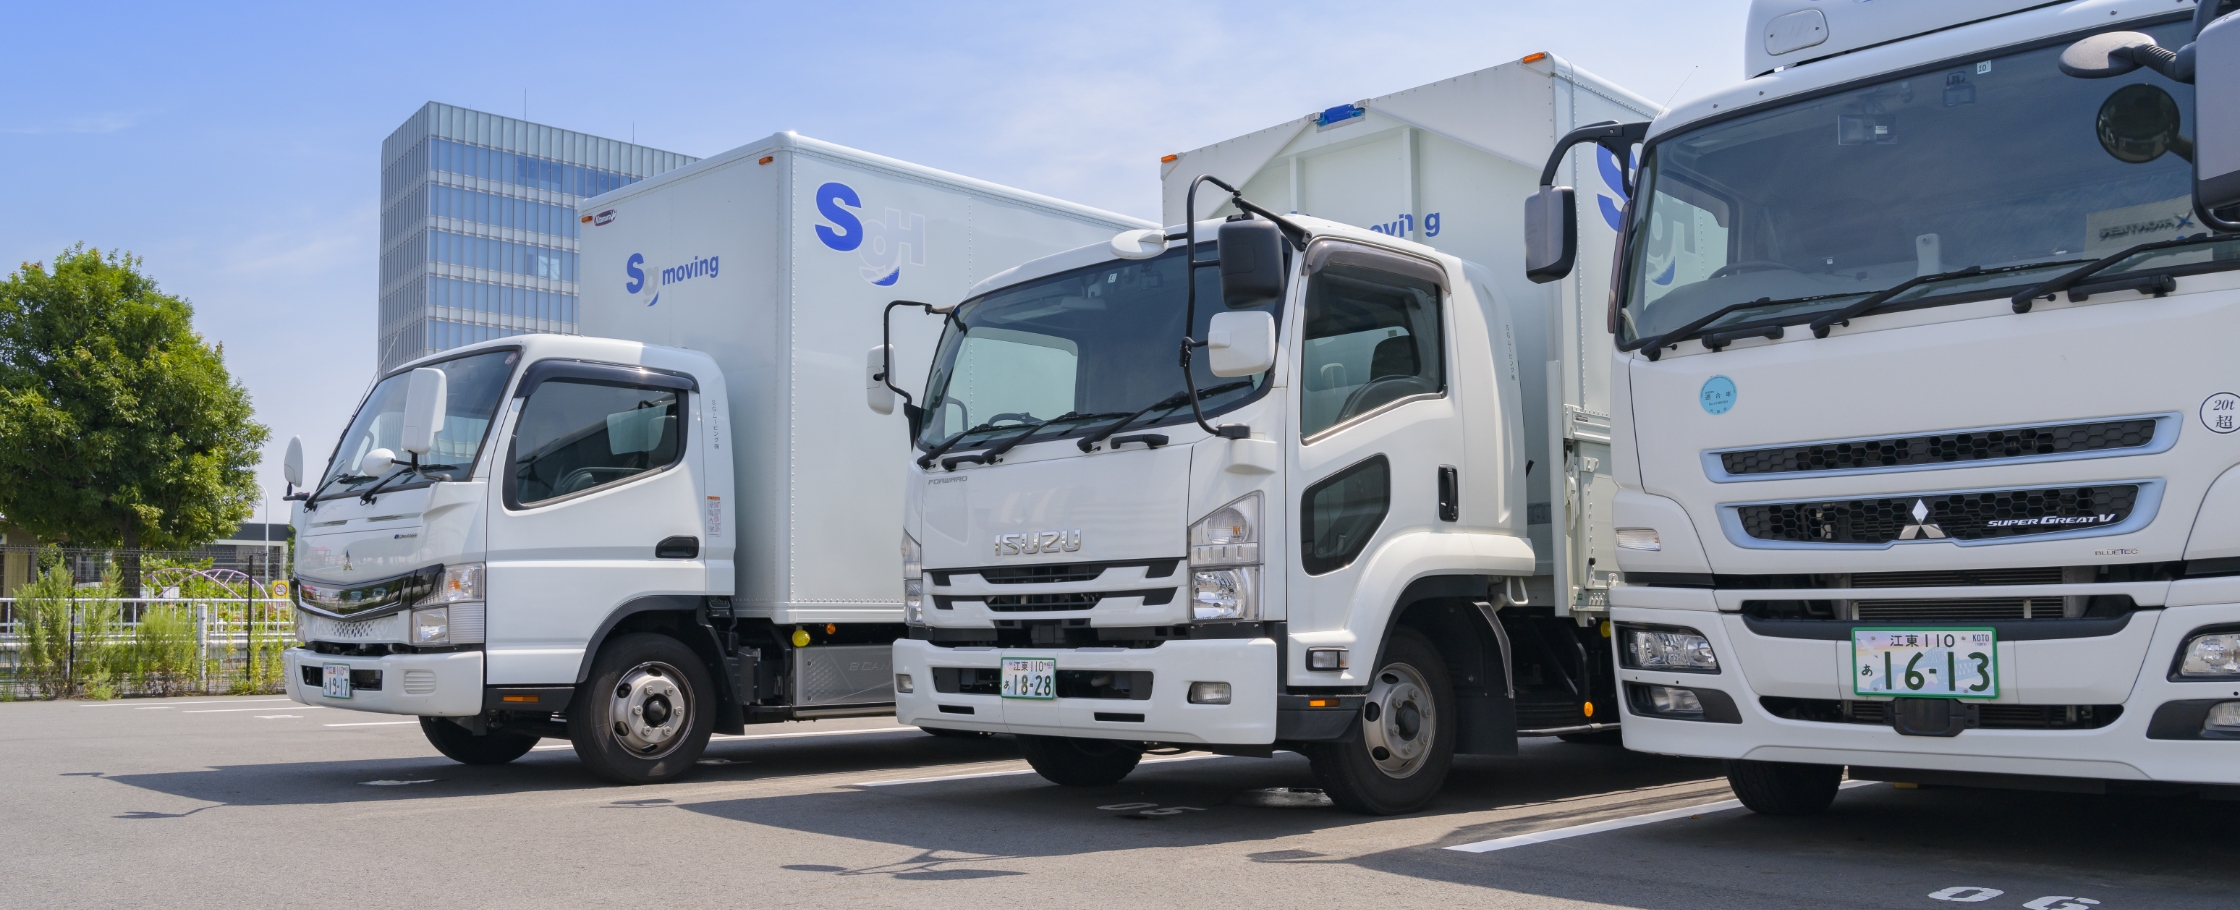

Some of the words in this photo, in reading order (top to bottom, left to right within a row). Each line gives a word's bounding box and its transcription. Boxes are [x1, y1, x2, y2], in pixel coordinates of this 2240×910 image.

[662, 255, 719, 286] moving
[2212, 399, 2235, 411] 20t
[2215, 415, 2233, 429] 超
[928, 475, 968, 485] FORWARD
[1987, 518, 2038, 528] SUPER
[2040, 515, 2097, 525] GREAT
[2098, 513, 2116, 523] V
[994, 528, 1082, 557] ISUZU
[1972, 633, 1990, 643] KOTO
[1861, 663, 1873, 677] あ
[1884, 651, 1991, 693] 16-13
[1014, 674, 1051, 697] 18-28
